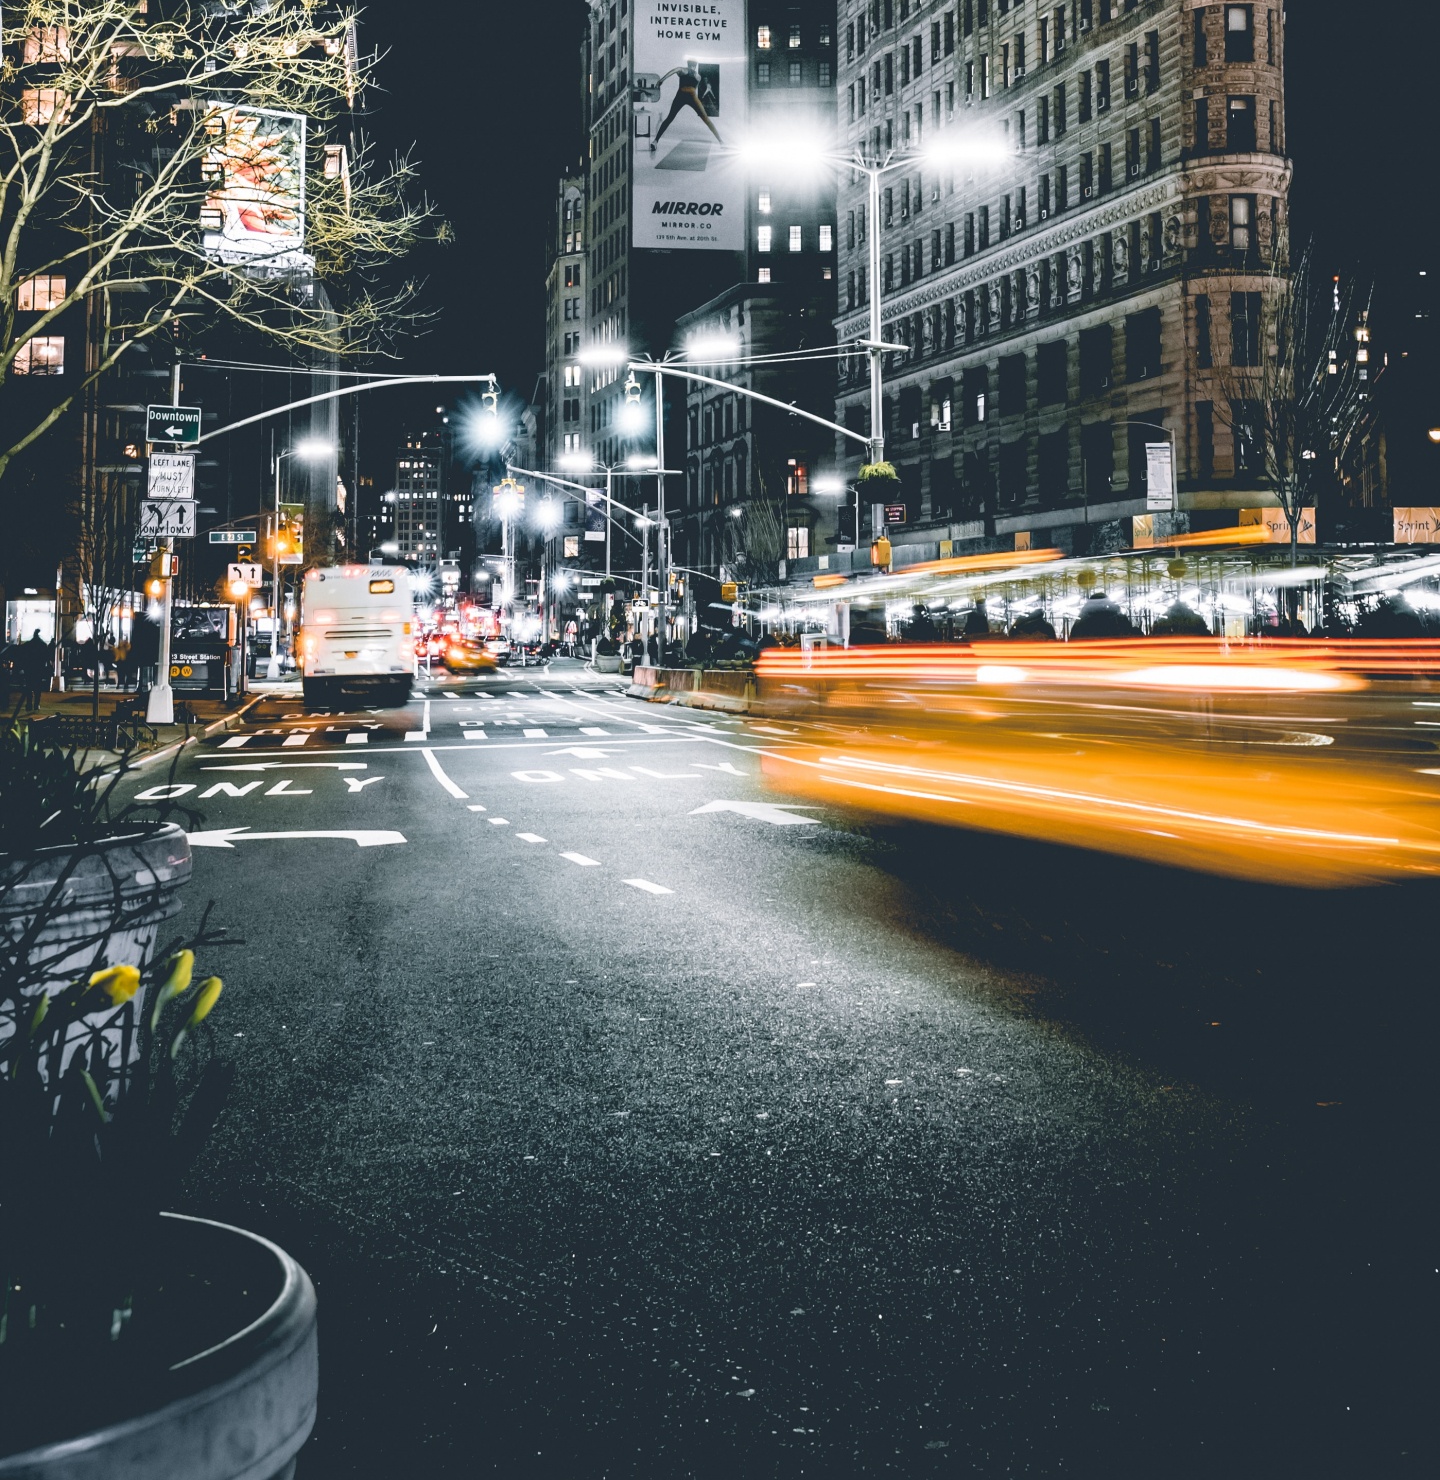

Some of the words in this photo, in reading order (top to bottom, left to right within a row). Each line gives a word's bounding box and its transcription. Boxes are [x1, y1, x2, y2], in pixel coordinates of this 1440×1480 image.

[657, 3, 721, 15] INVISIBLE,
[650, 16, 727, 28] INTERACTIVE
[657, 30, 691, 39] HOME
[696, 32, 721, 41] GYM
[652, 201, 724, 216] MIRROR
[150, 410, 199, 422] Downtown
[160, 472, 183, 481] MUST
[174, 485, 189, 493] LEFT
[170, 526, 191, 534] ONLY
[1266, 521, 1289, 533] Spri
[1398, 520, 1429, 532] Sprint
[281, 709, 384, 719] ONLY
[458, 716, 584, 727] ONLY
[255, 723, 384, 735] ONLY
[510, 762, 751, 783] ONLY
[134, 776, 386, 800] ONLY
